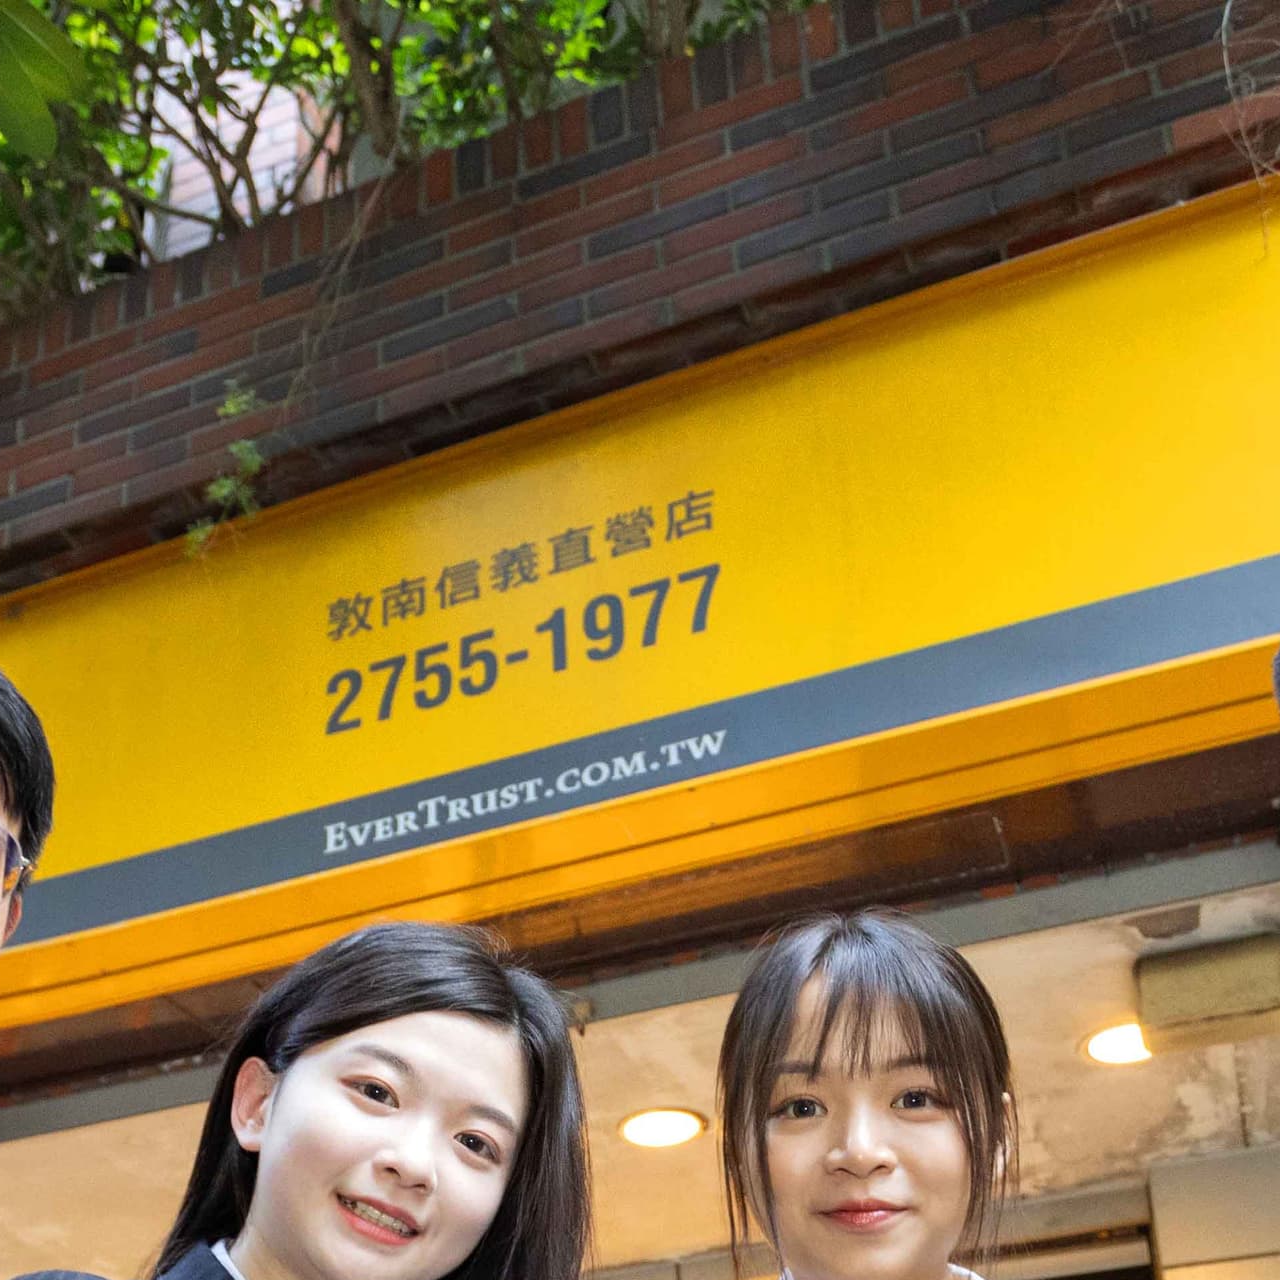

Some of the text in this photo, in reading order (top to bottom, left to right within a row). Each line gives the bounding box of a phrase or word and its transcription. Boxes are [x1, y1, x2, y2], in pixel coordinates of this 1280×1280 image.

[327, 489, 715, 642] 敦南信義直營店
[324, 563, 721, 736] 2755-1977
